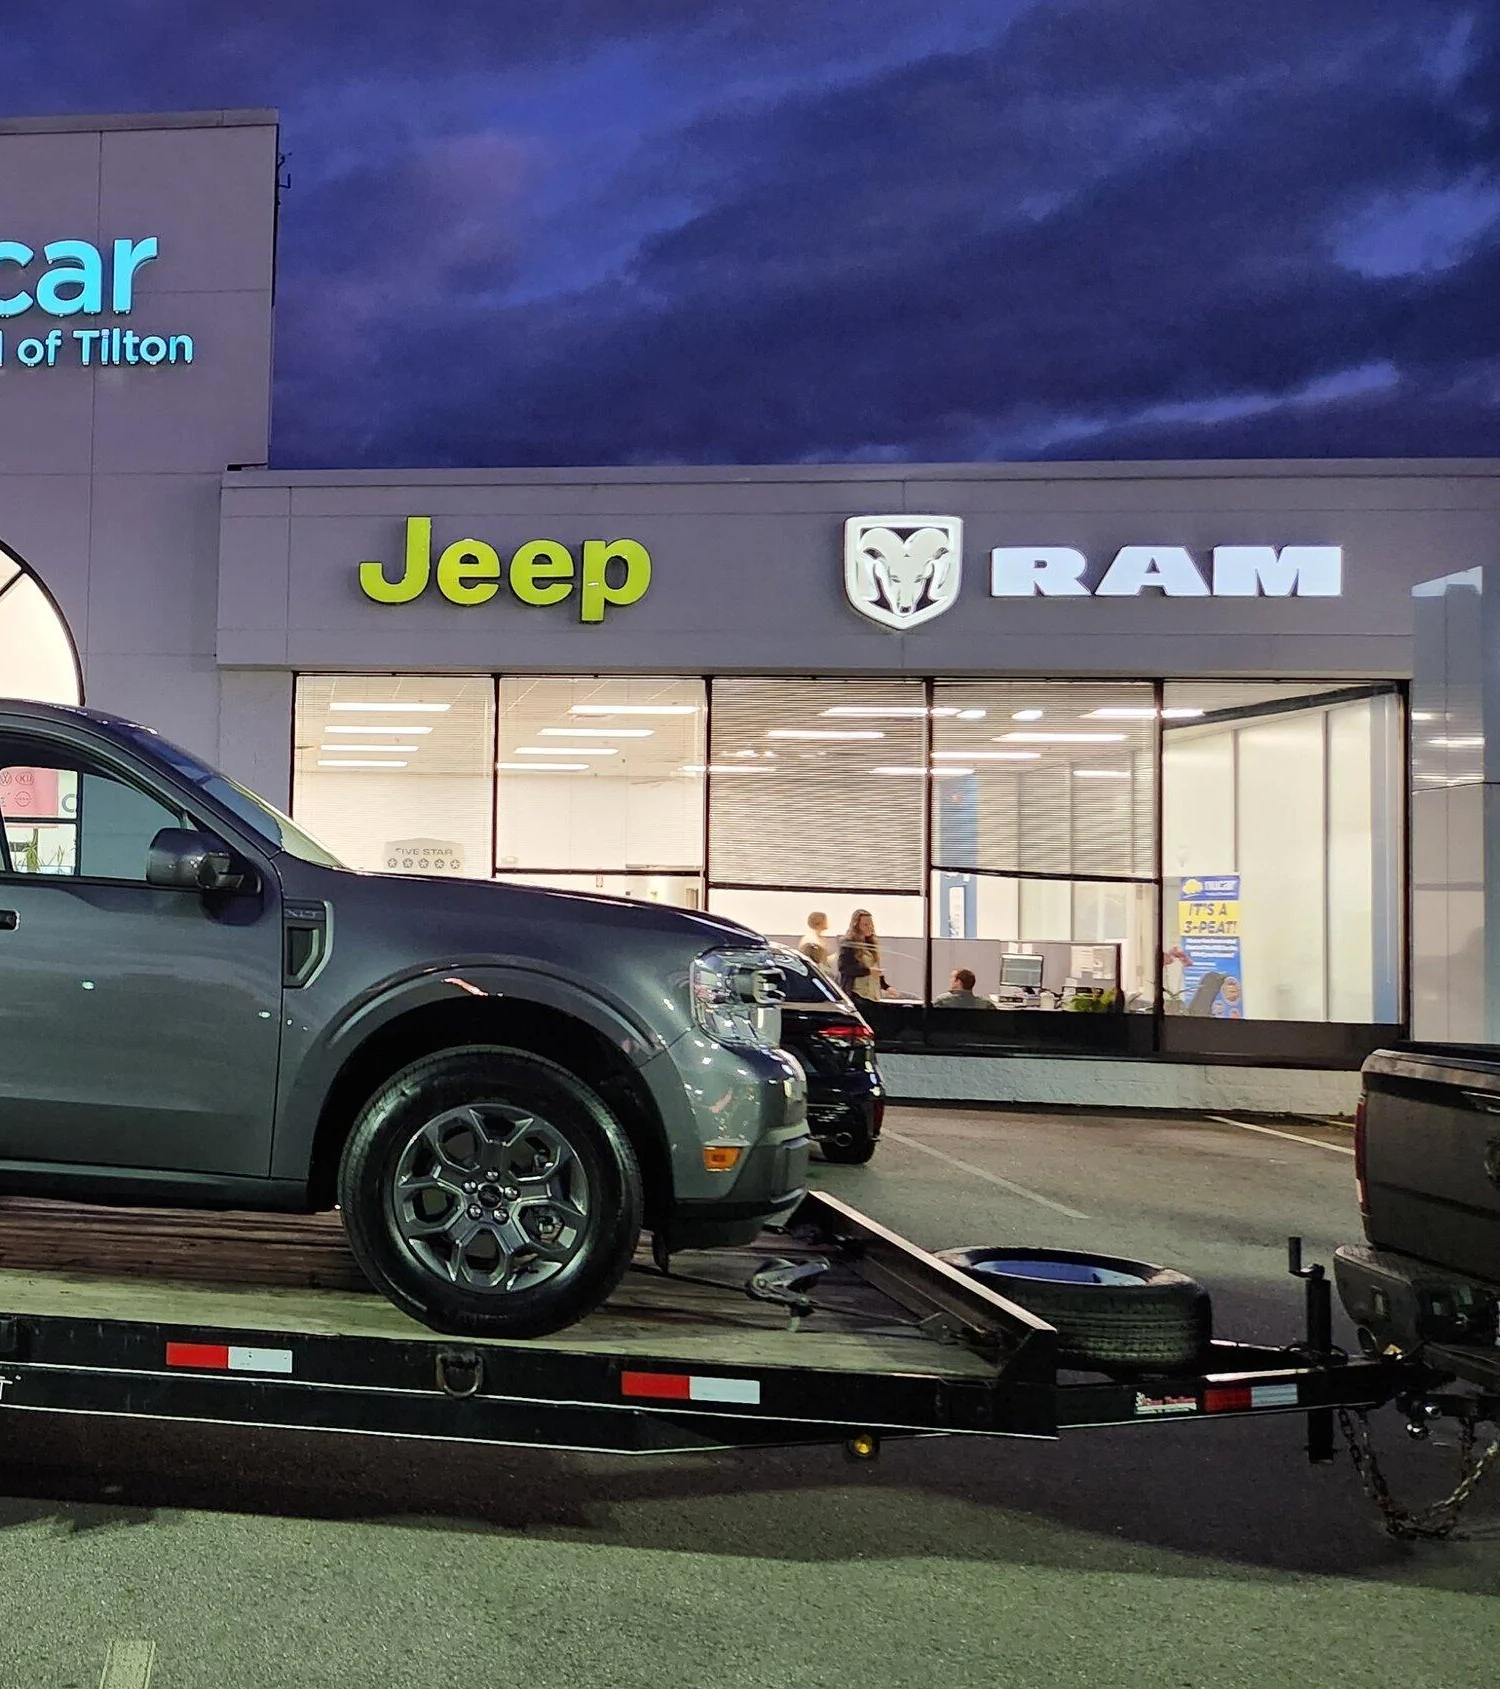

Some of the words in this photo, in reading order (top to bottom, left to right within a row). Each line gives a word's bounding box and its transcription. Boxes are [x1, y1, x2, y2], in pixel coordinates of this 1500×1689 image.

[17, 329, 62, 367] of
[73, 327, 194, 366] Tilton
[358, 516, 652, 623] Jeep
[990, 545, 1342, 597] RAM
[395, 847, 420, 856] FIVE
[422, 848, 453, 857] STAR
[1188, 902, 1215, 916] IT'S
[1218, 902, 1228, 916] A
